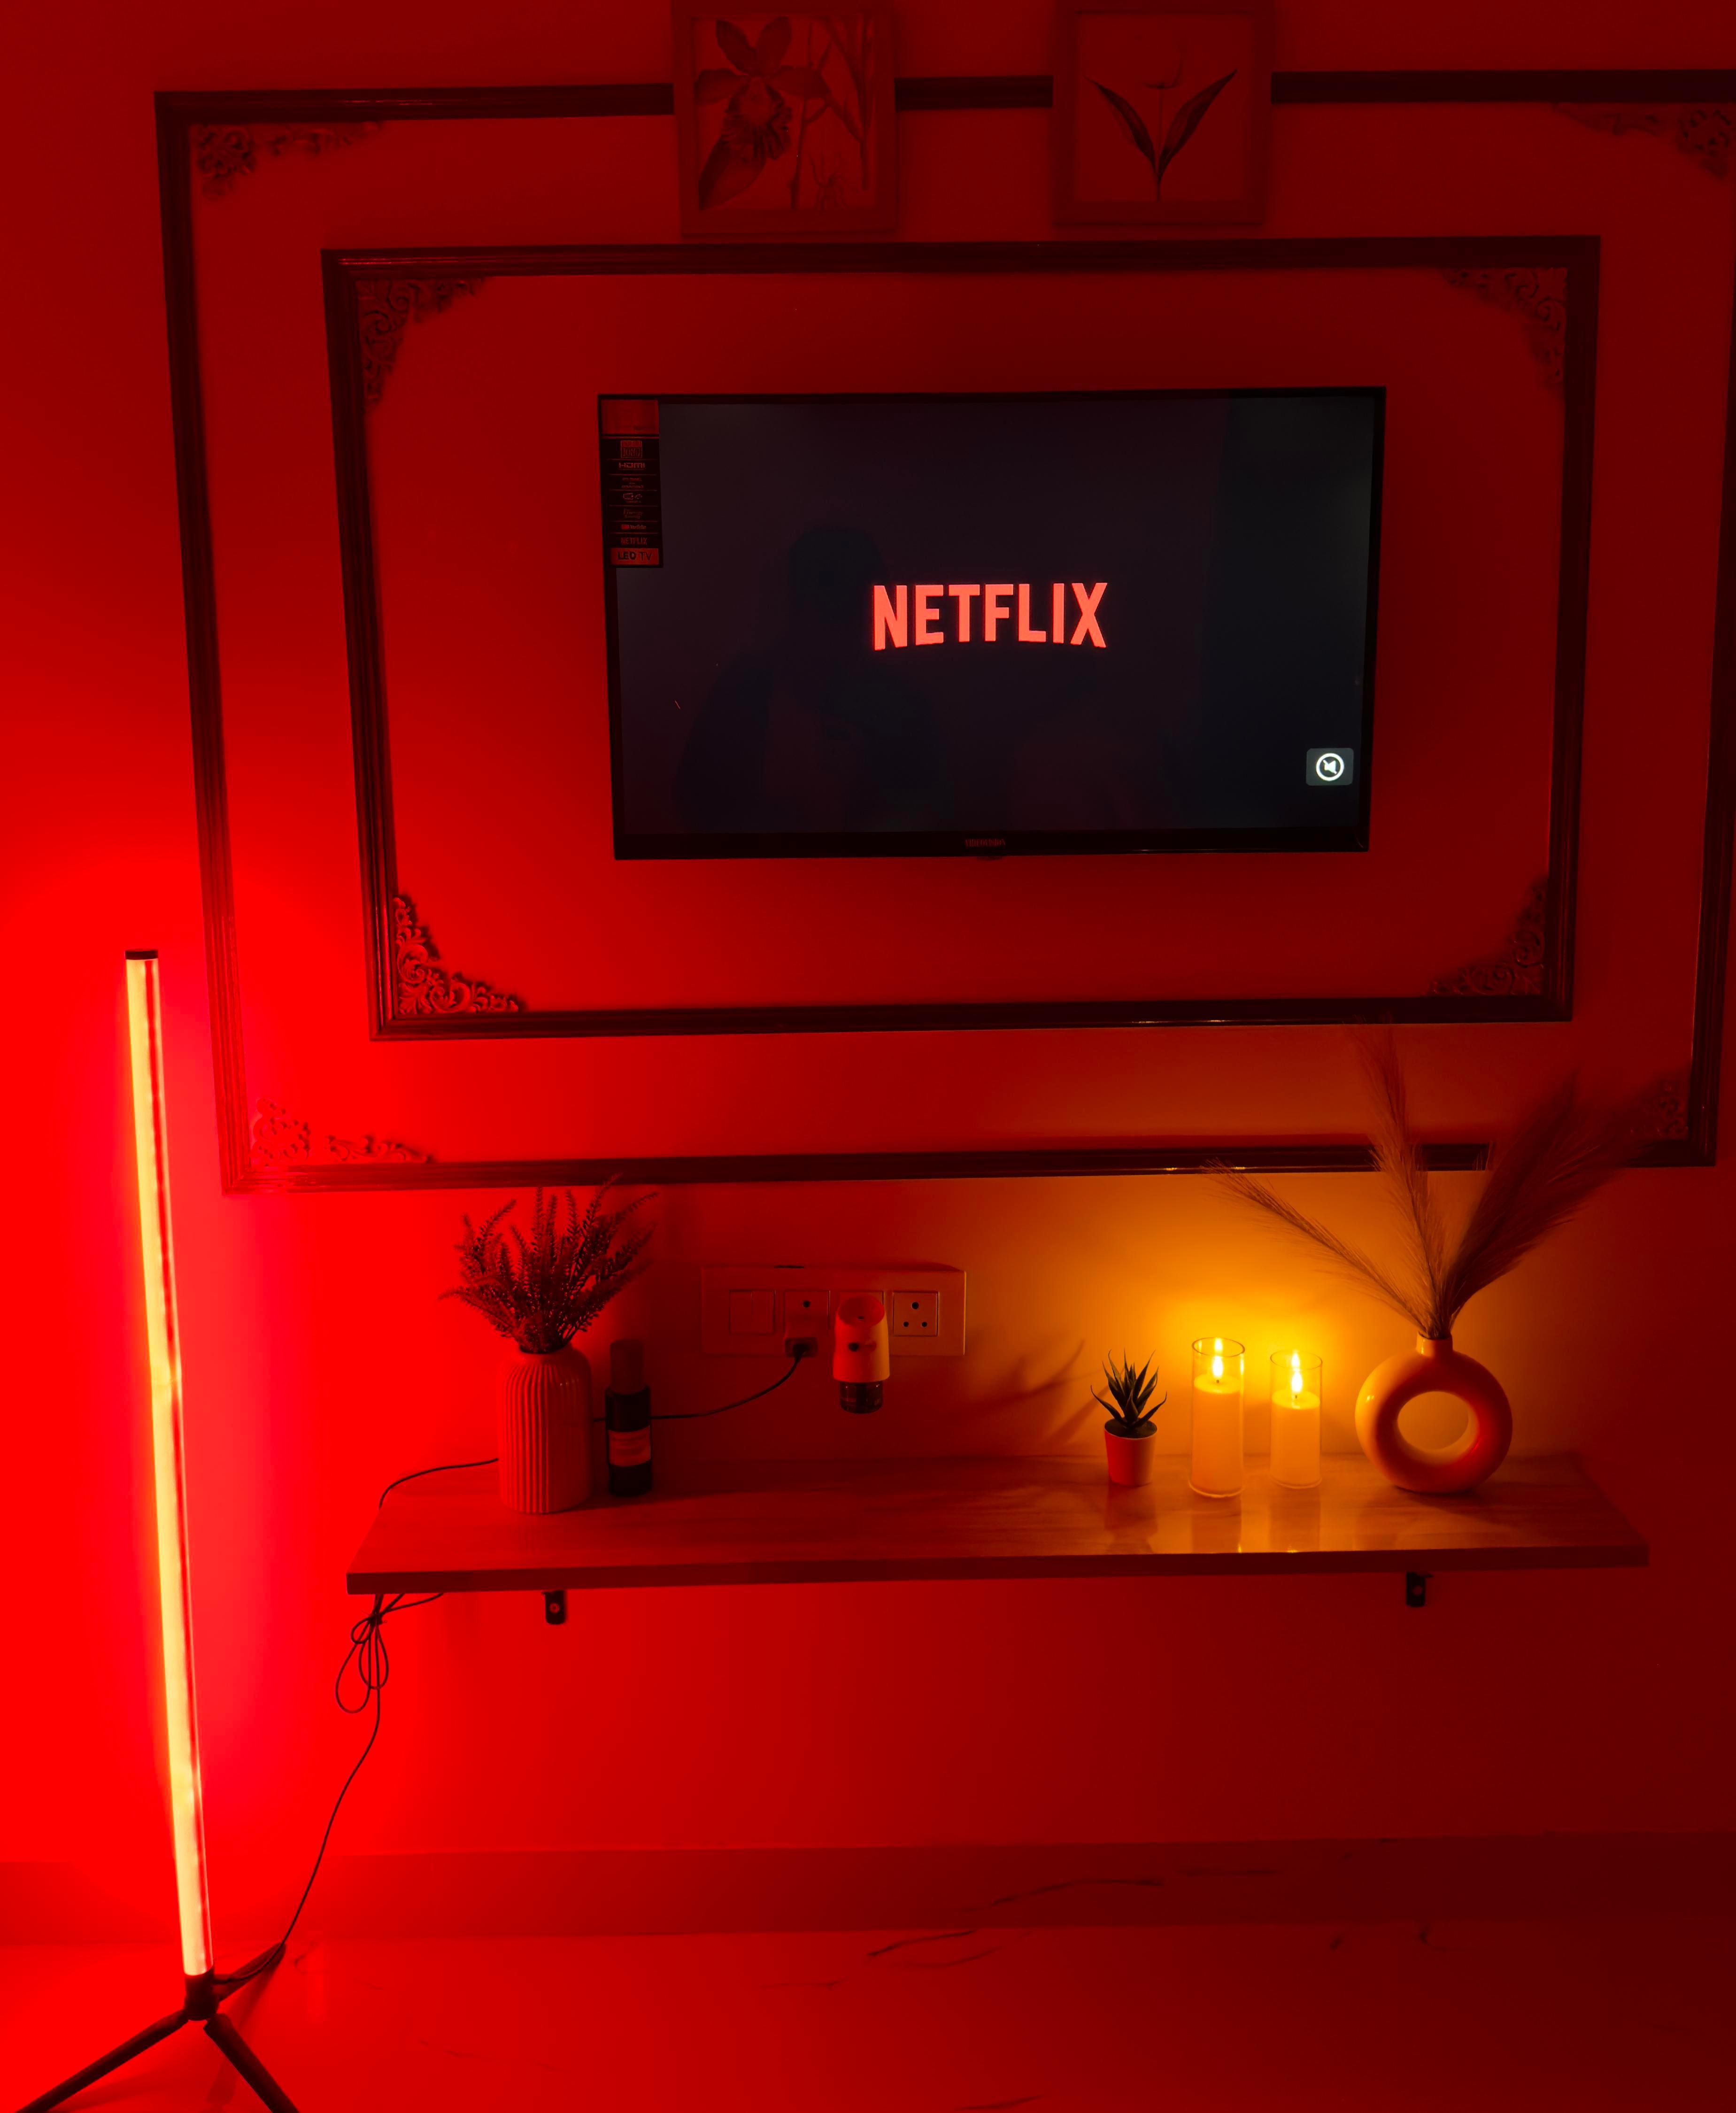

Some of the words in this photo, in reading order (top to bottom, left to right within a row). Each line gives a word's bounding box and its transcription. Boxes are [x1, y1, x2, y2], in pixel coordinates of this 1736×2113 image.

[617, 551, 636, 560] LED
[638, 551, 652, 561] TV
[874, 583, 1107, 650] NETFLIX
